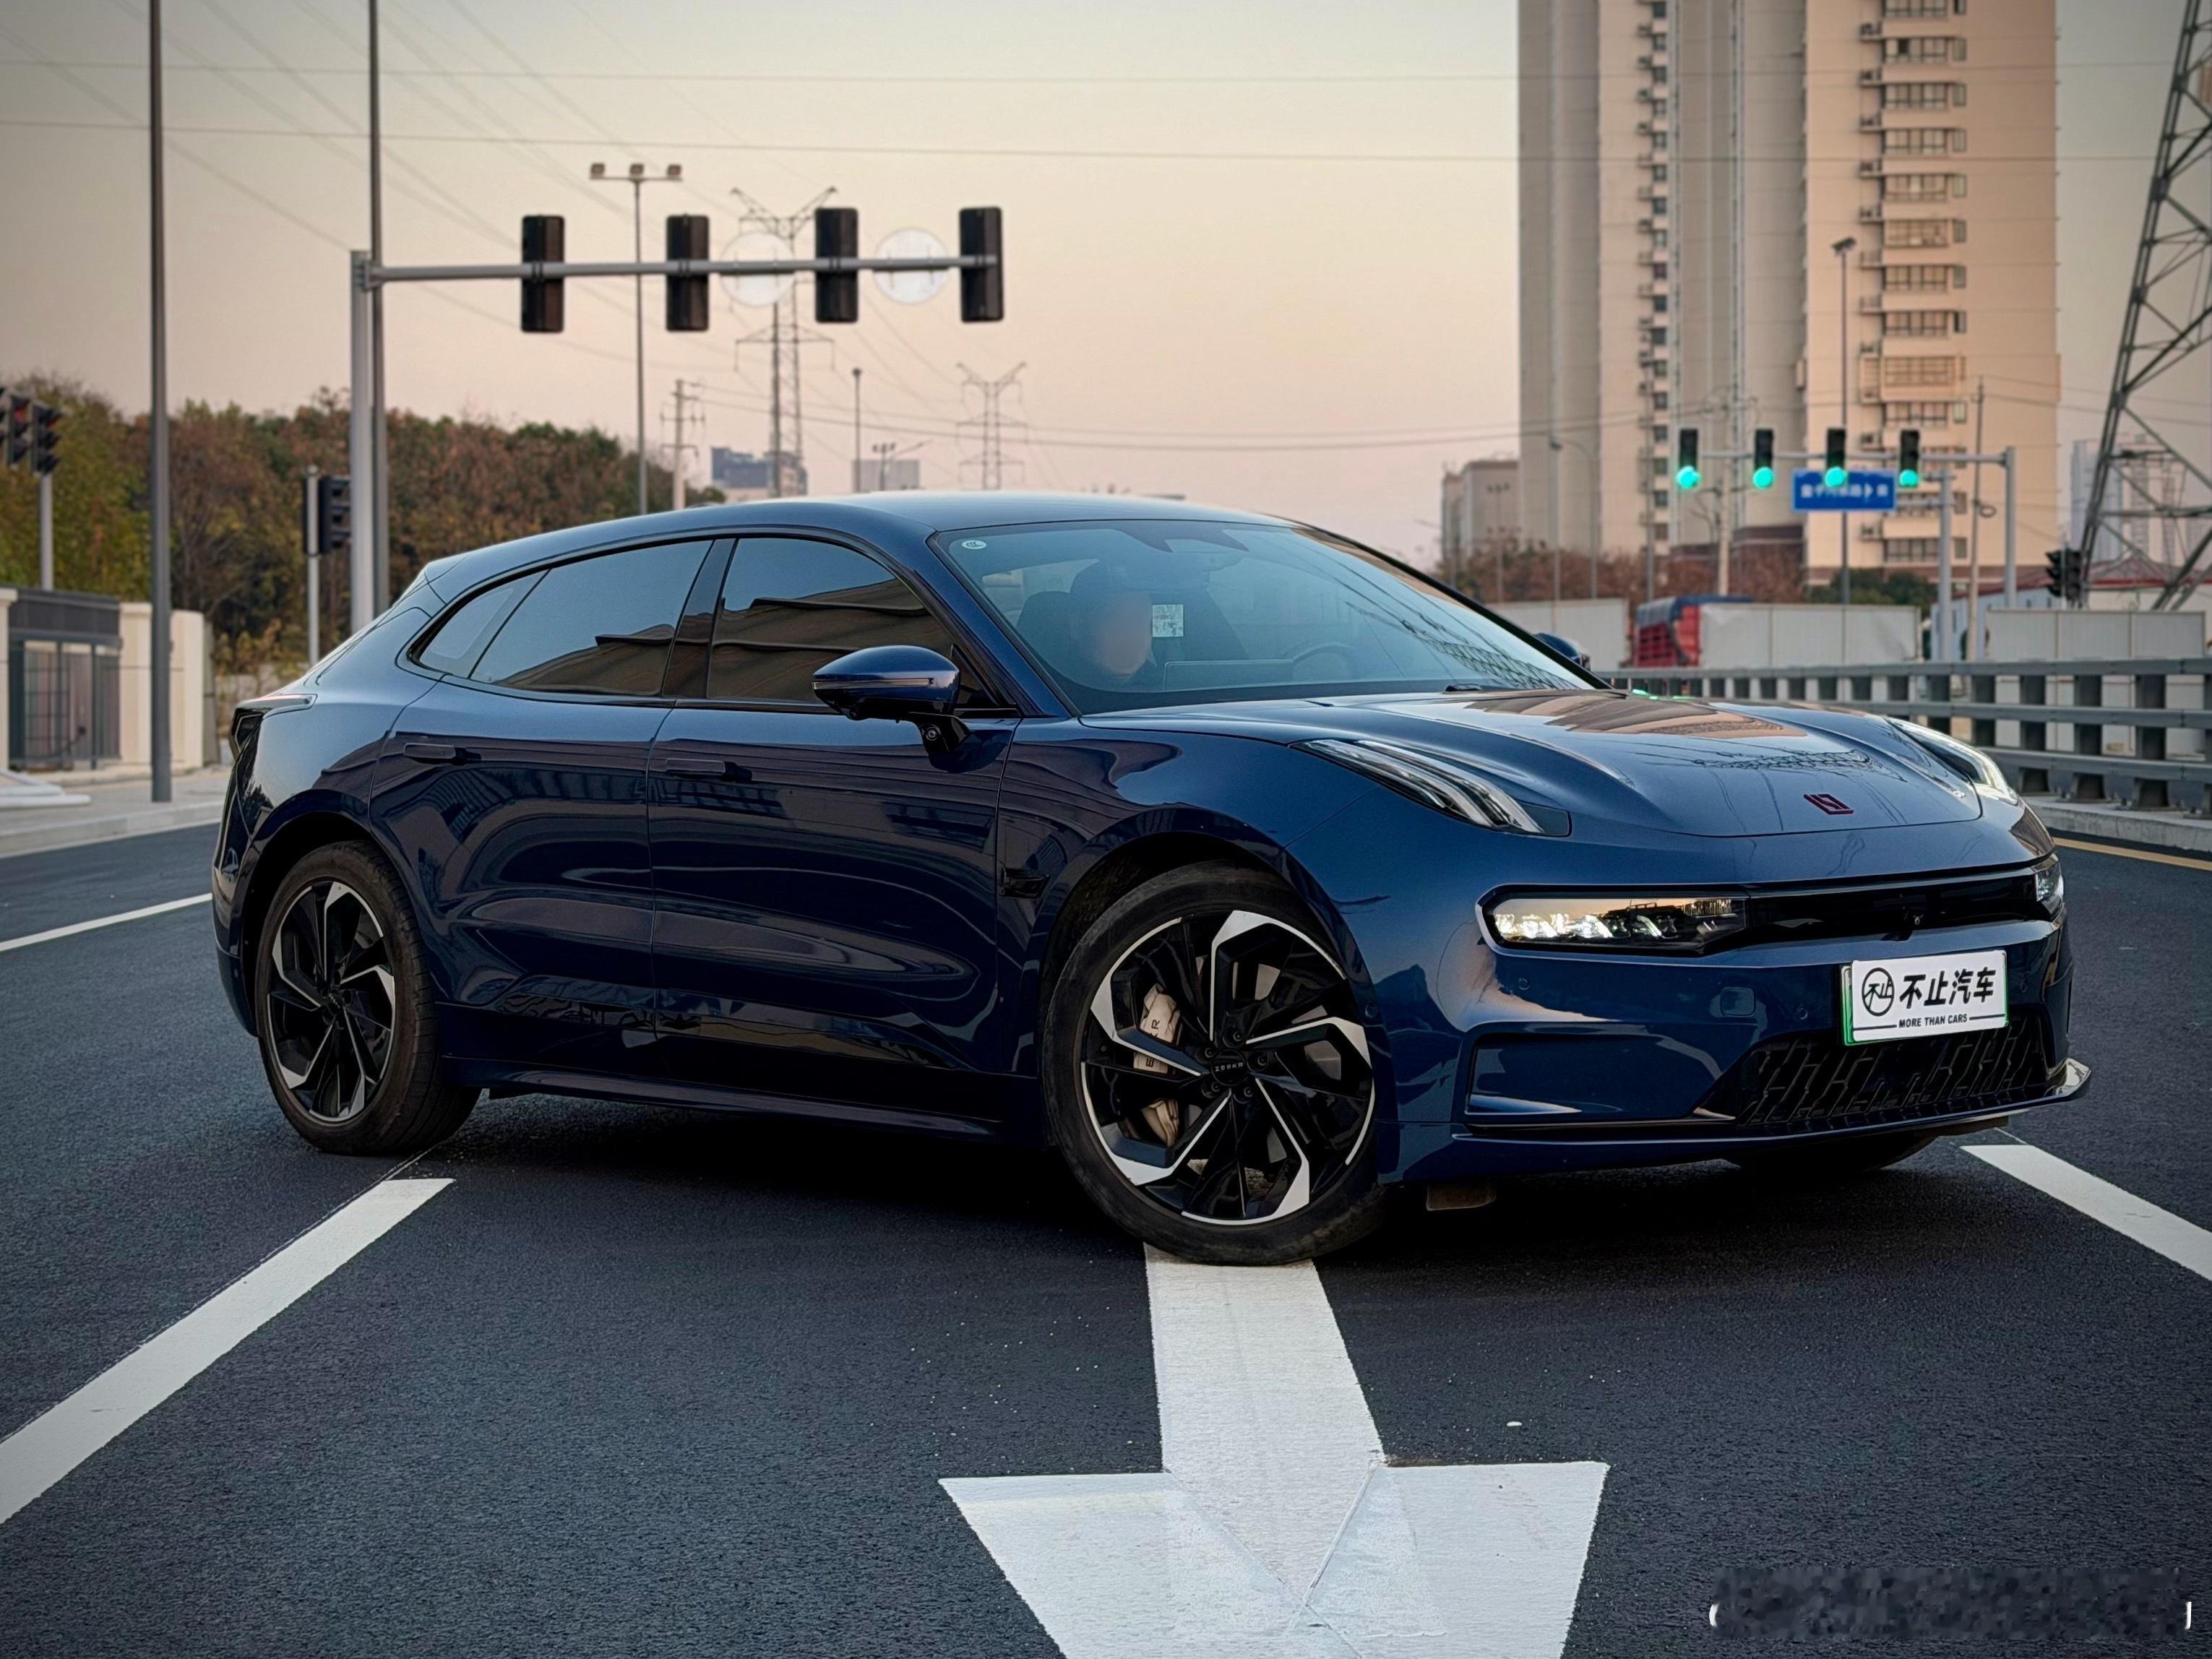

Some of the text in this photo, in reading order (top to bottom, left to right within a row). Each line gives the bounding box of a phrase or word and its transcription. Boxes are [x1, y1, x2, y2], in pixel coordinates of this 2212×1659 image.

[1899, 967, 1996, 1009] 不止汽车
[1898, 1014, 1968, 1028] MORE THAN CARS
